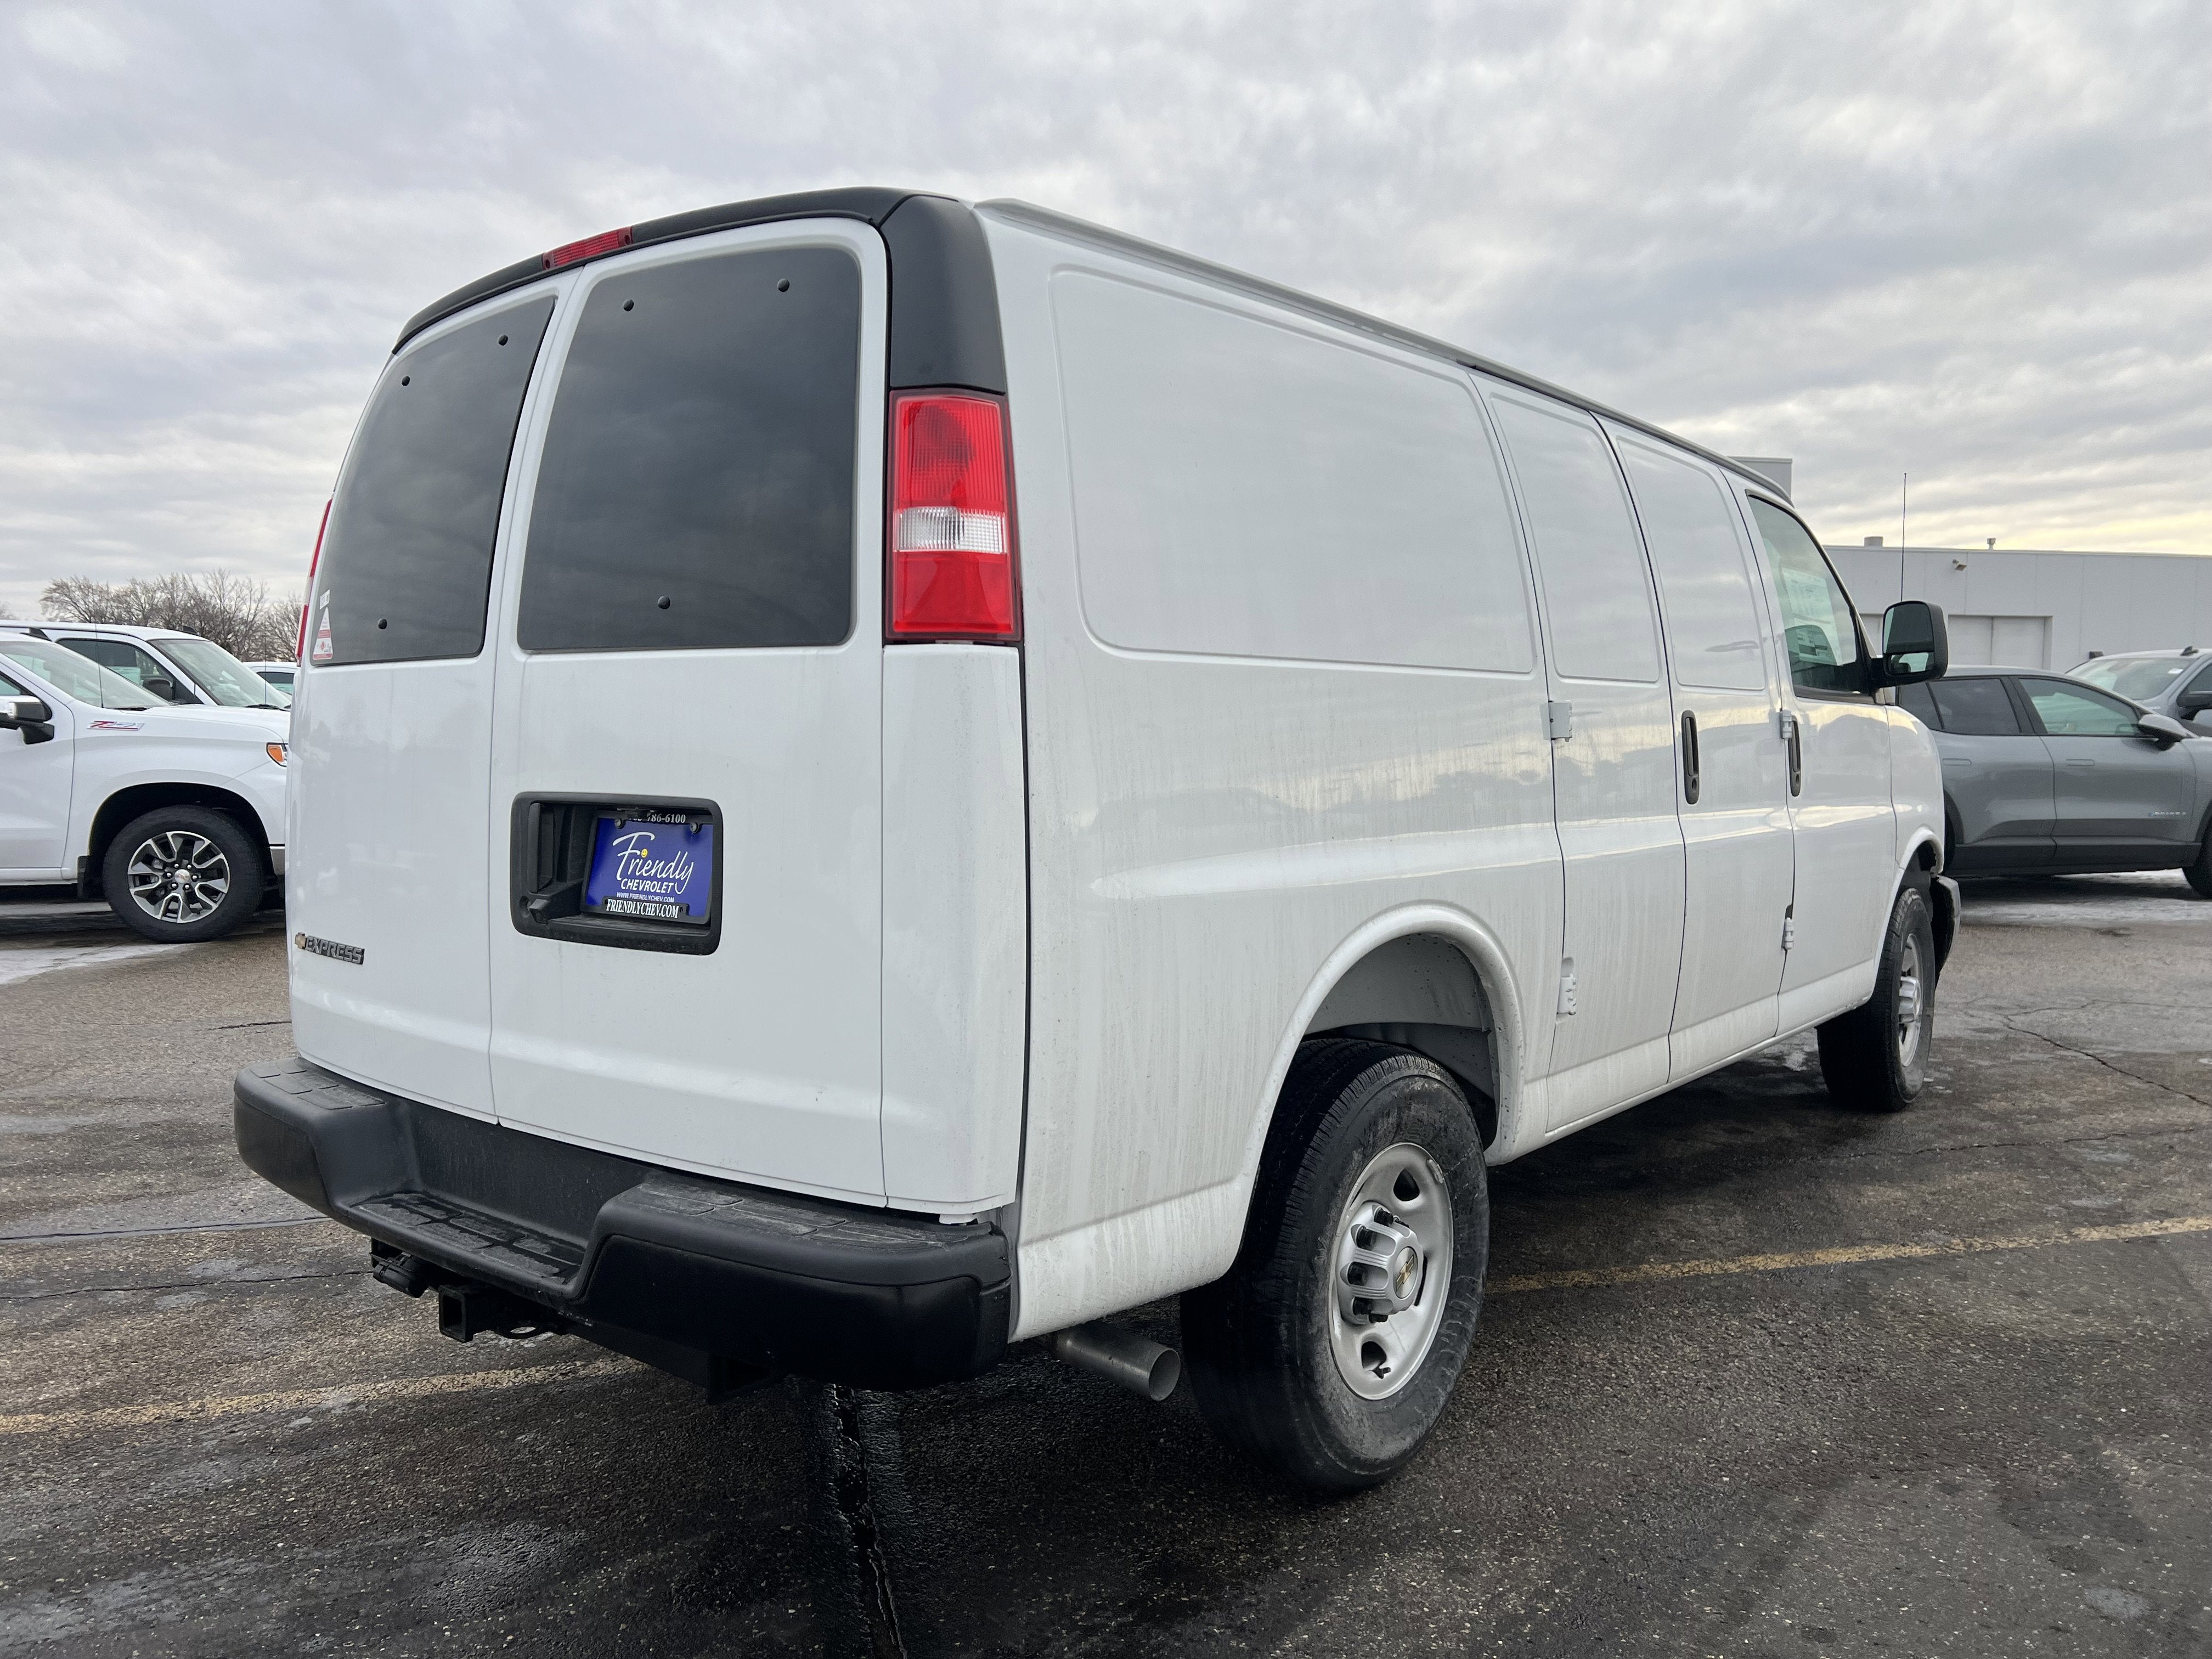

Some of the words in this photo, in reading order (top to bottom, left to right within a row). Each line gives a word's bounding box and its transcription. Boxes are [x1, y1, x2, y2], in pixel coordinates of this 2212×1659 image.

[612, 832, 694, 894] Friendly
[620, 878, 674, 894] CHEVROLET
[617, 891, 675, 903] WWW.FRIENDLYCHEV.COM
[606, 899, 680, 918] FRIENDLYCHEV.COM
[305, 935, 363, 964] EXPRESS
